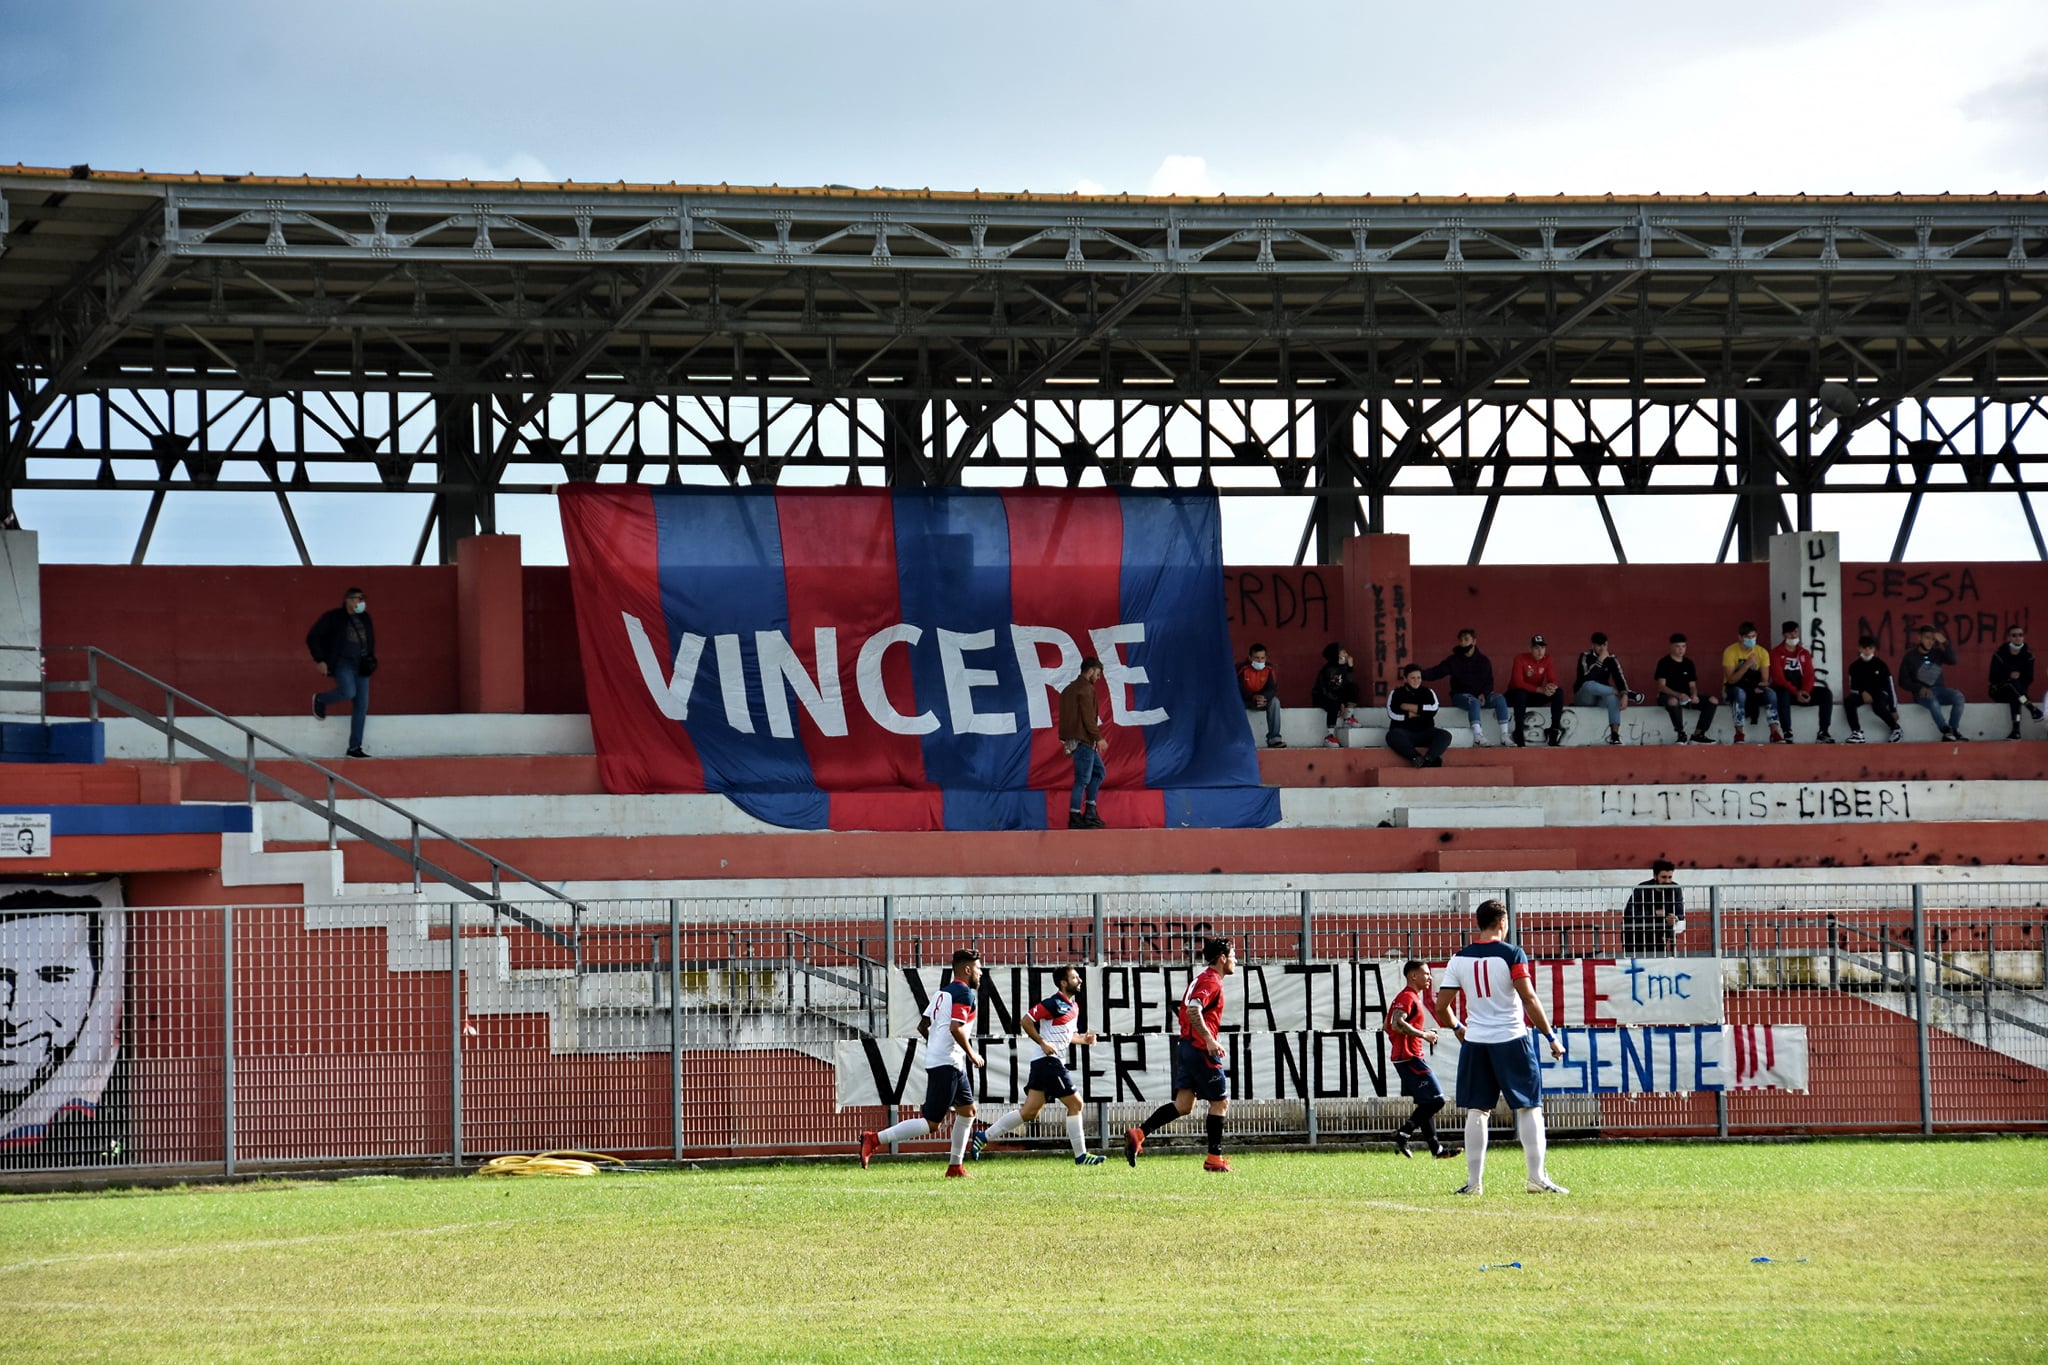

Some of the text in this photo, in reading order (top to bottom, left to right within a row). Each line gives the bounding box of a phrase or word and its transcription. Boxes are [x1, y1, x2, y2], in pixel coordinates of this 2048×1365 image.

[1802, 539, 1828, 688] ULTRAS
[1853, 567, 1980, 604] SESSA
[621, 611, 1170, 739] VINCERE
[1284, 963, 1388, 1031] TUA
[1474, 959, 1491, 998] 11
[1624, 958, 1692, 1006] tmc
[1274, 1030, 1388, 1100] NON
